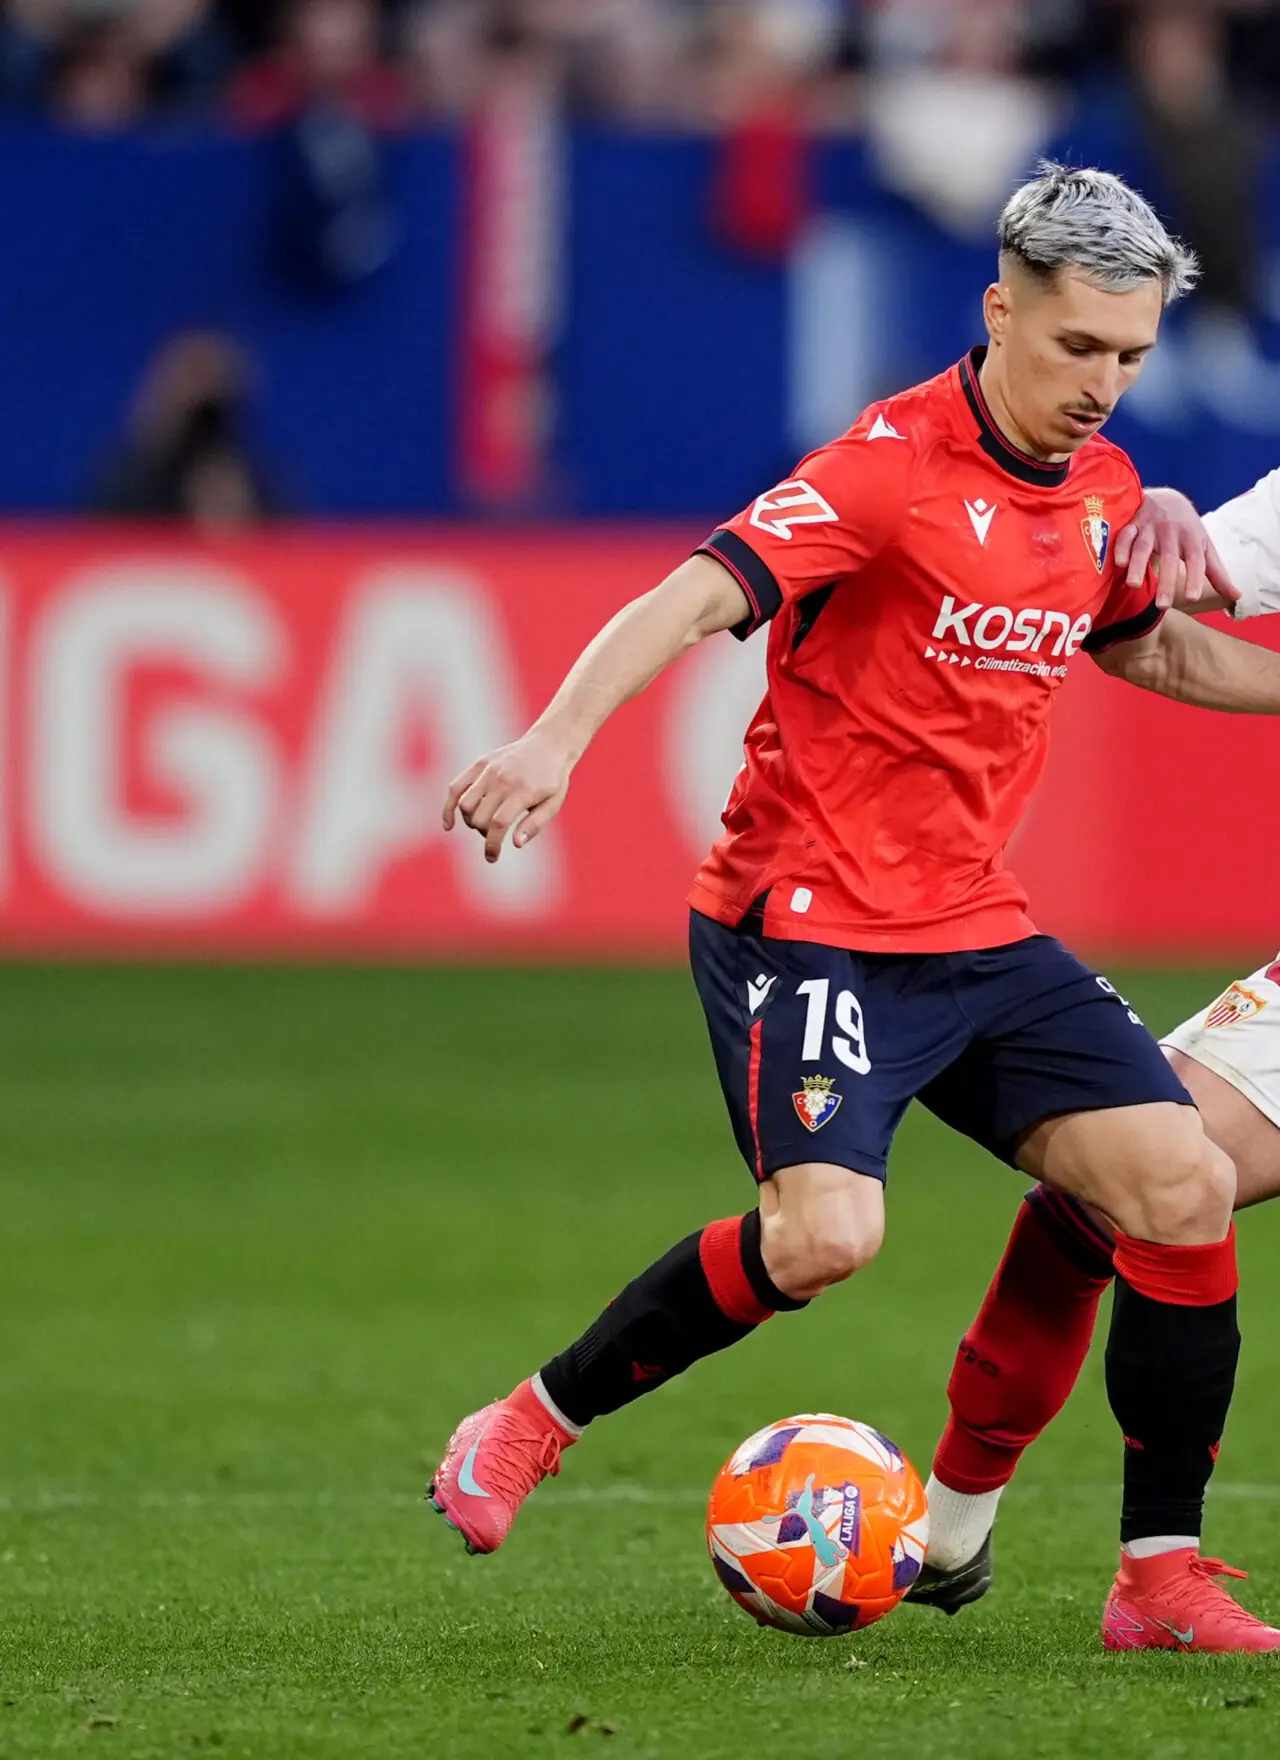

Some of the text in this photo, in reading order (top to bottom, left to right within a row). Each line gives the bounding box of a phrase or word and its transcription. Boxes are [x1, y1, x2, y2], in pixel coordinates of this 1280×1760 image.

[0, 563, 562, 916] GA
[796, 979, 871, 1075] 19
[841, 1501, 856, 1542] LALIGA
